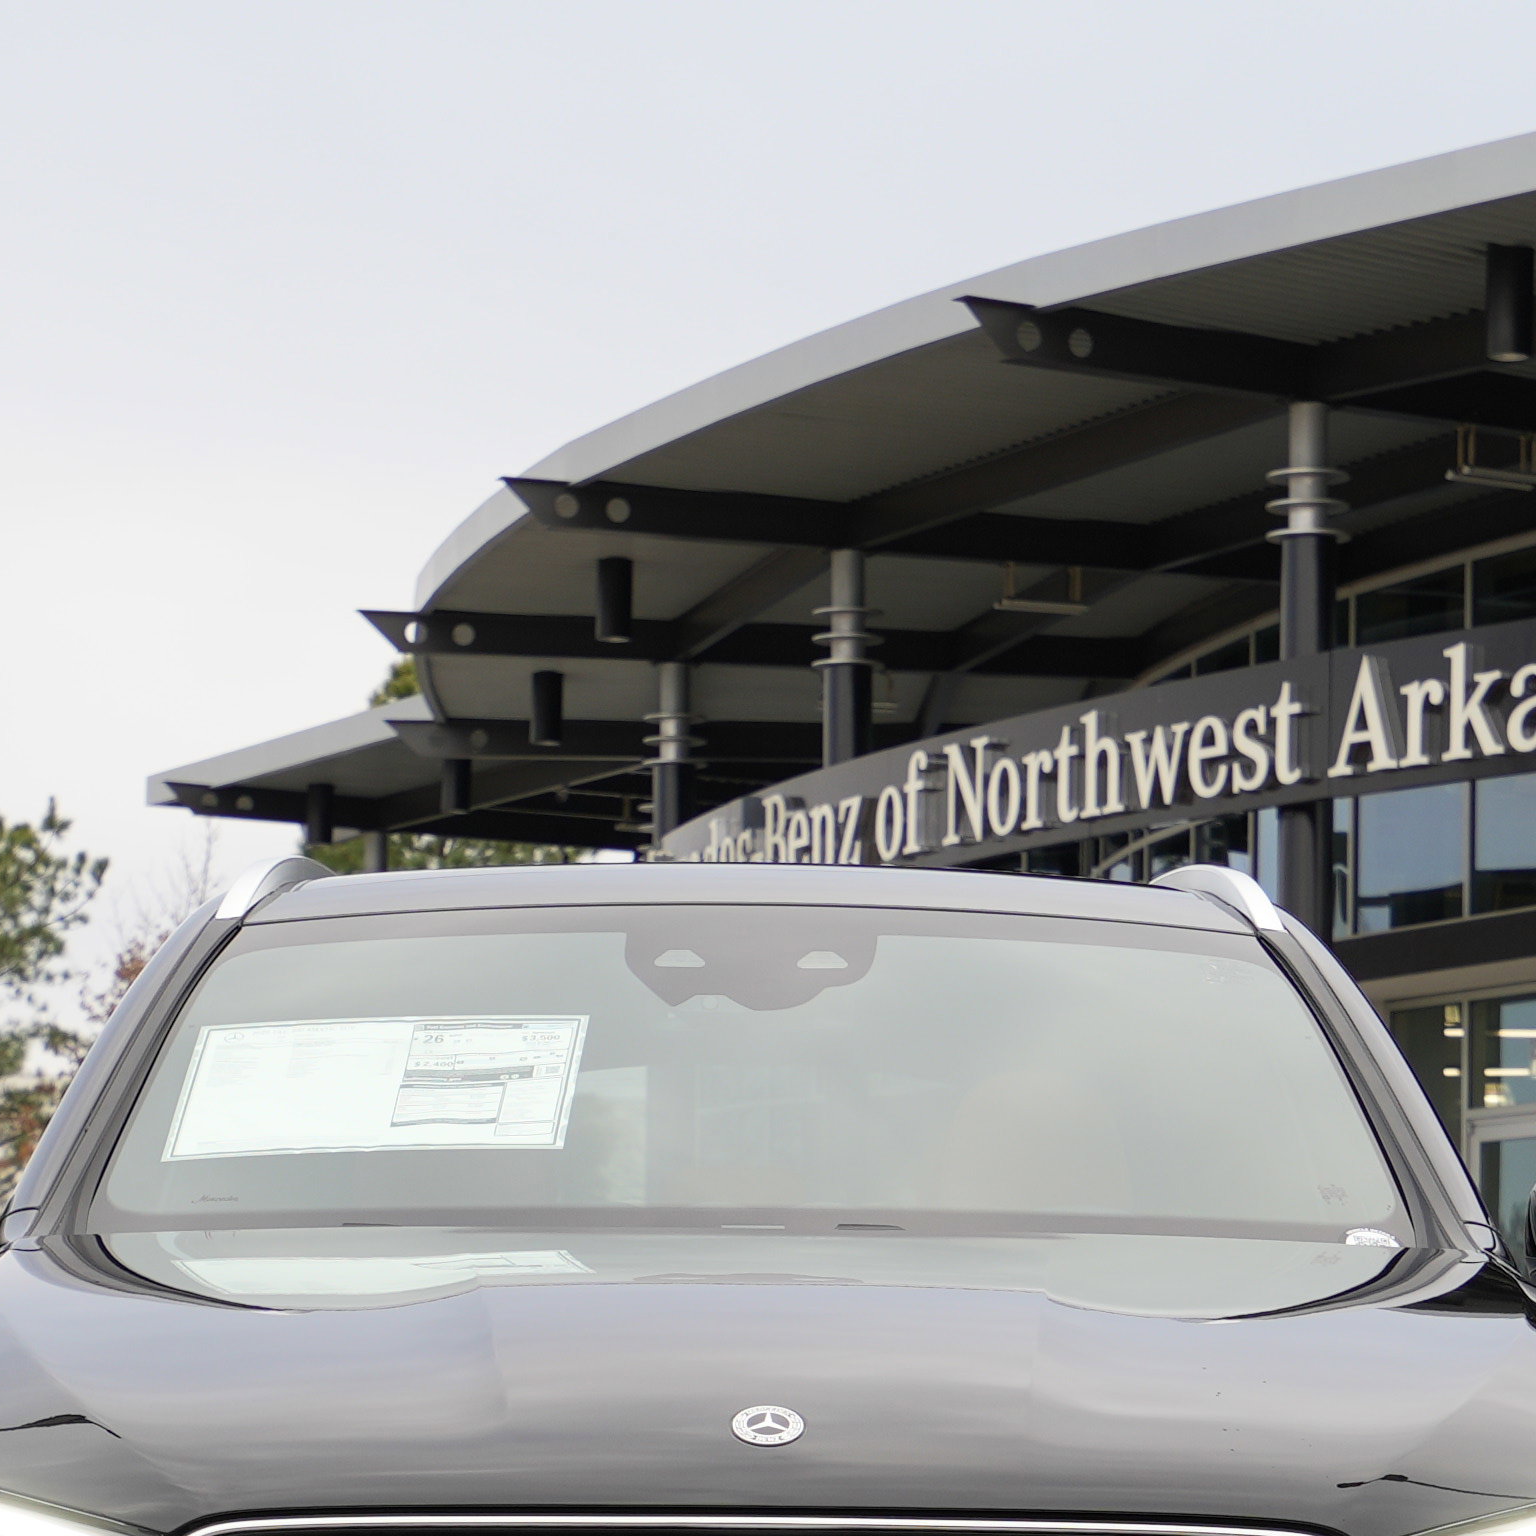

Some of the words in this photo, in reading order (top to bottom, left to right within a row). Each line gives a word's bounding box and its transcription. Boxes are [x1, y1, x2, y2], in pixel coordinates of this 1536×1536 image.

[875, 749, 929, 862] of
[942, 680, 1302, 846] Northwest
[421, 1034, 445, 1044] 26
